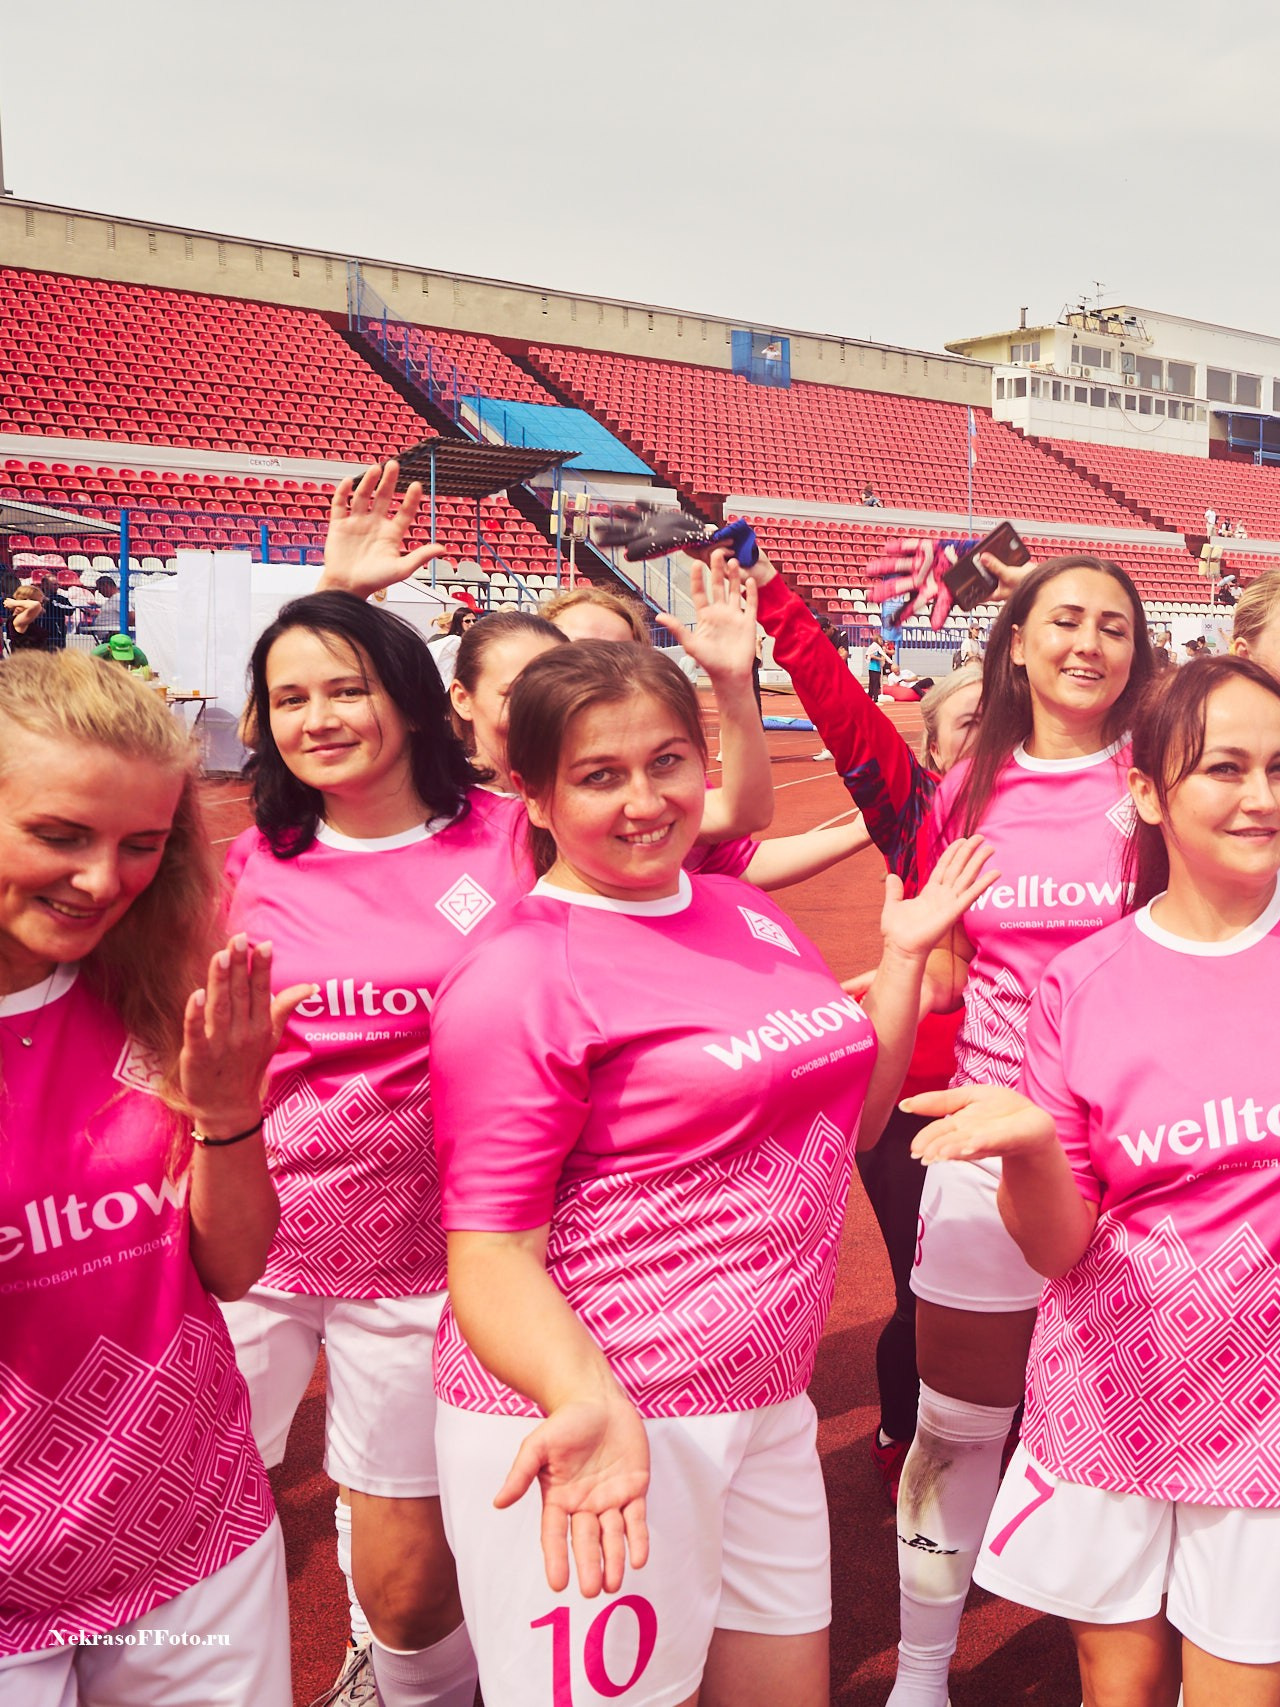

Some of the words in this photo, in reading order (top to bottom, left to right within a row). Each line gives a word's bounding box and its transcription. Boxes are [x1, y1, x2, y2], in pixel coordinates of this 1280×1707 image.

[1000, 919, 1044, 930] основан
[1046, 919, 1066, 929] для
[1067, 917, 1103, 928] людей
[305, 1031, 363, 1042] основан
[365, 1031, 390, 1042] для
[791, 1054, 829, 1079] основан
[829, 1047, 846, 1064] для
[846, 1035, 874, 1055] людей
[1252, 1158, 1279, 1169] для
[0, 1267, 78, 1294] основан
[82, 1254, 113, 1275] для
[117, 1232, 172, 1262] людей
[989, 1463, 1055, 1557] 7
[530, 1594, 658, 1707] 10
